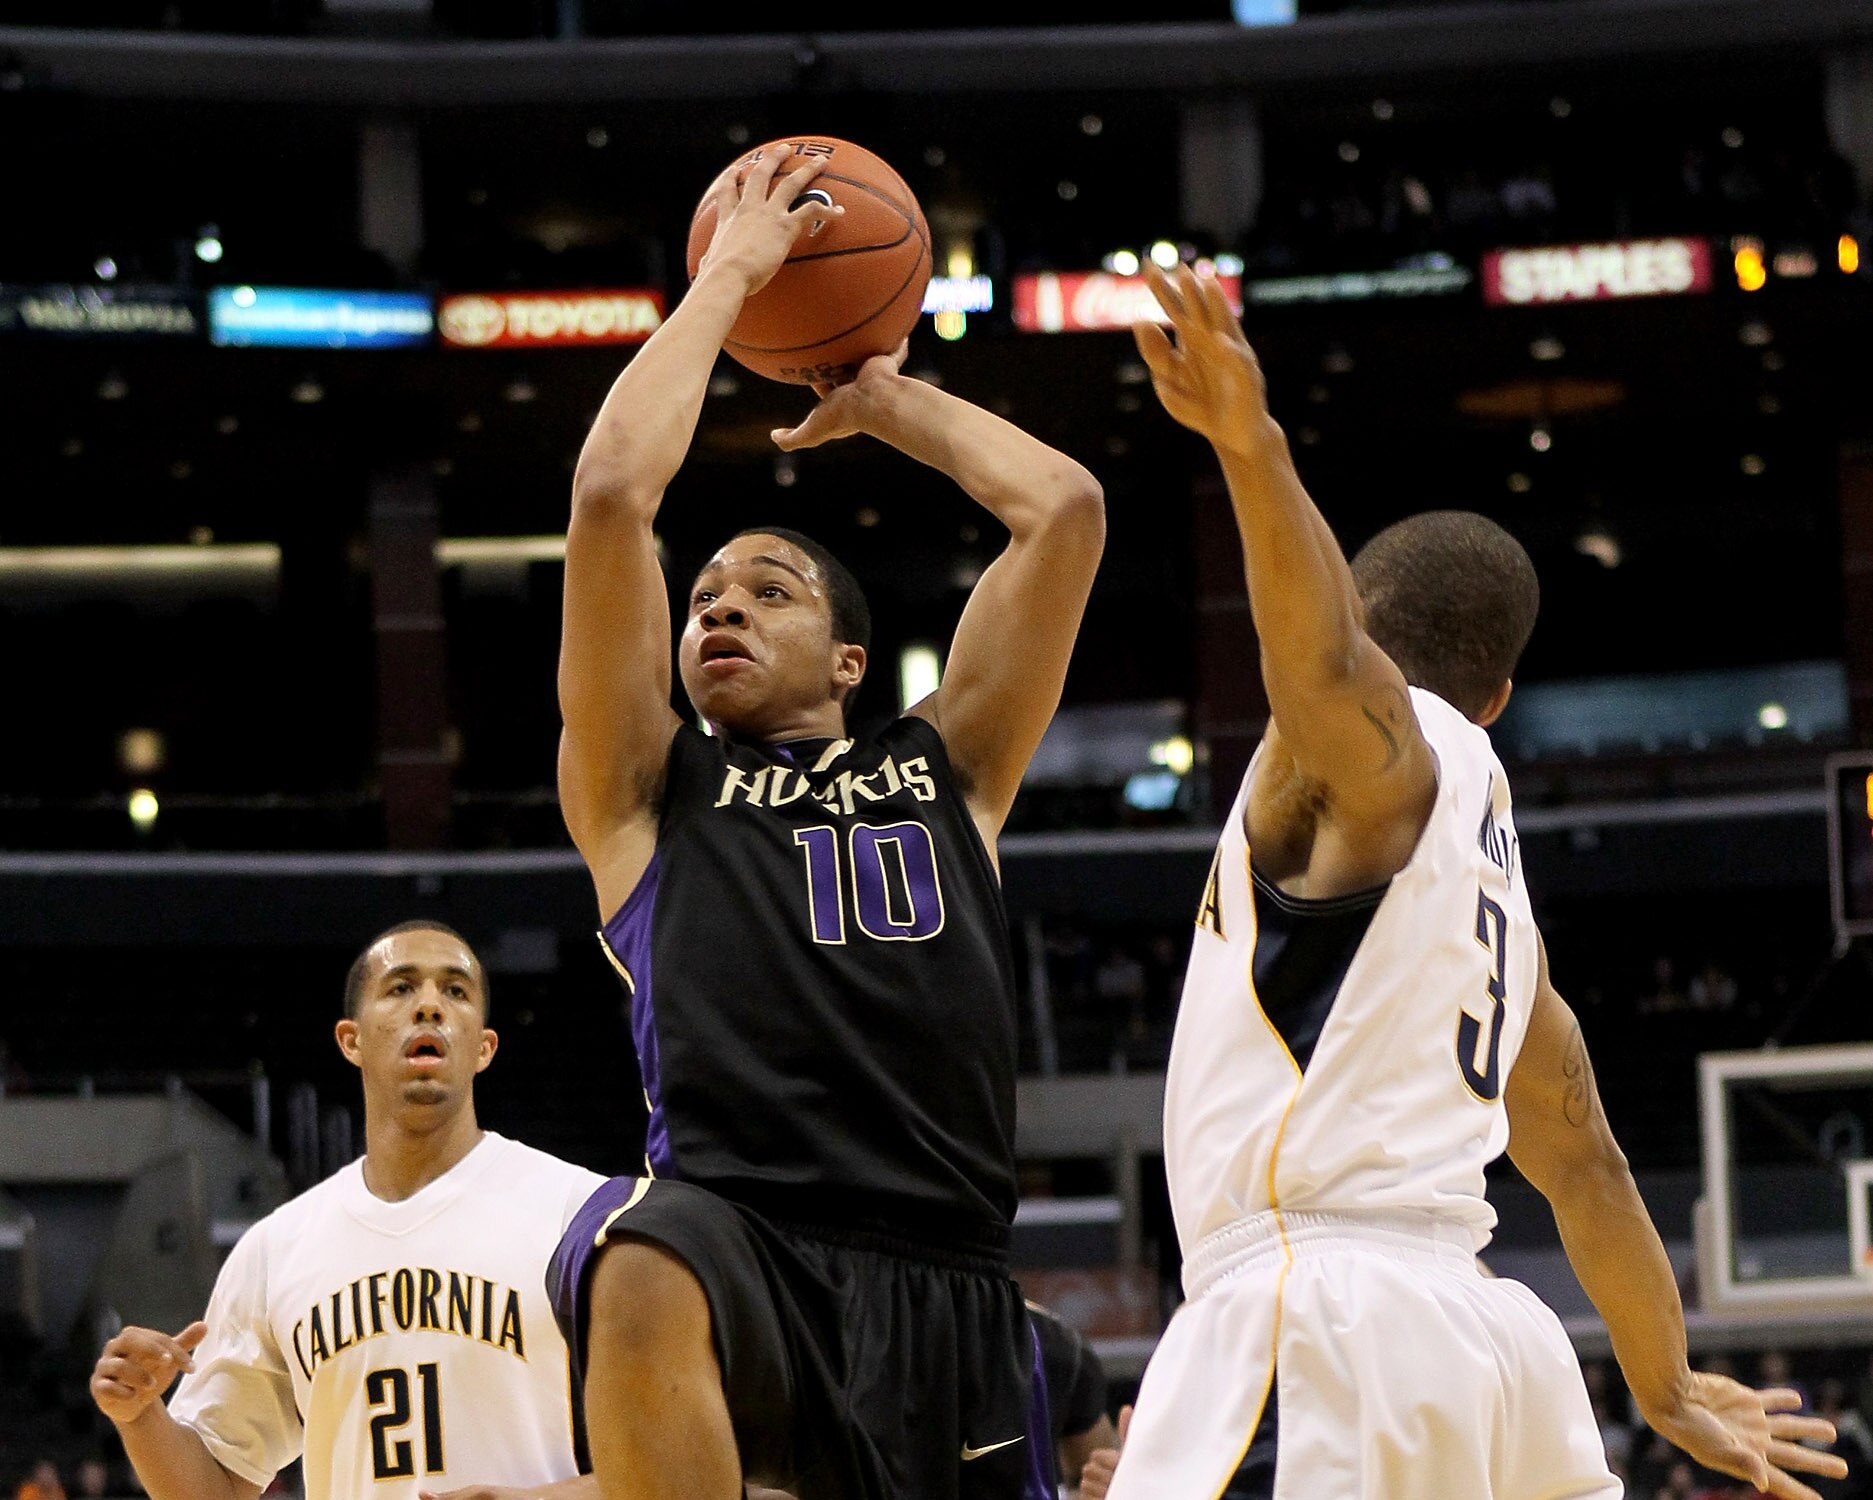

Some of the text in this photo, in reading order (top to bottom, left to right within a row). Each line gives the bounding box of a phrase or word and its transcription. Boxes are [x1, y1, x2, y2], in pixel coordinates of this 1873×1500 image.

[506, 297, 663, 339] TOYOTA
[1500, 238, 1694, 304] STAPLES
[792, 820, 946, 946] 10
[1454, 884, 1508, 1106] 3
[292, 1266, 530, 1384] CALIFORNIA
[365, 1360, 447, 1483] 21
